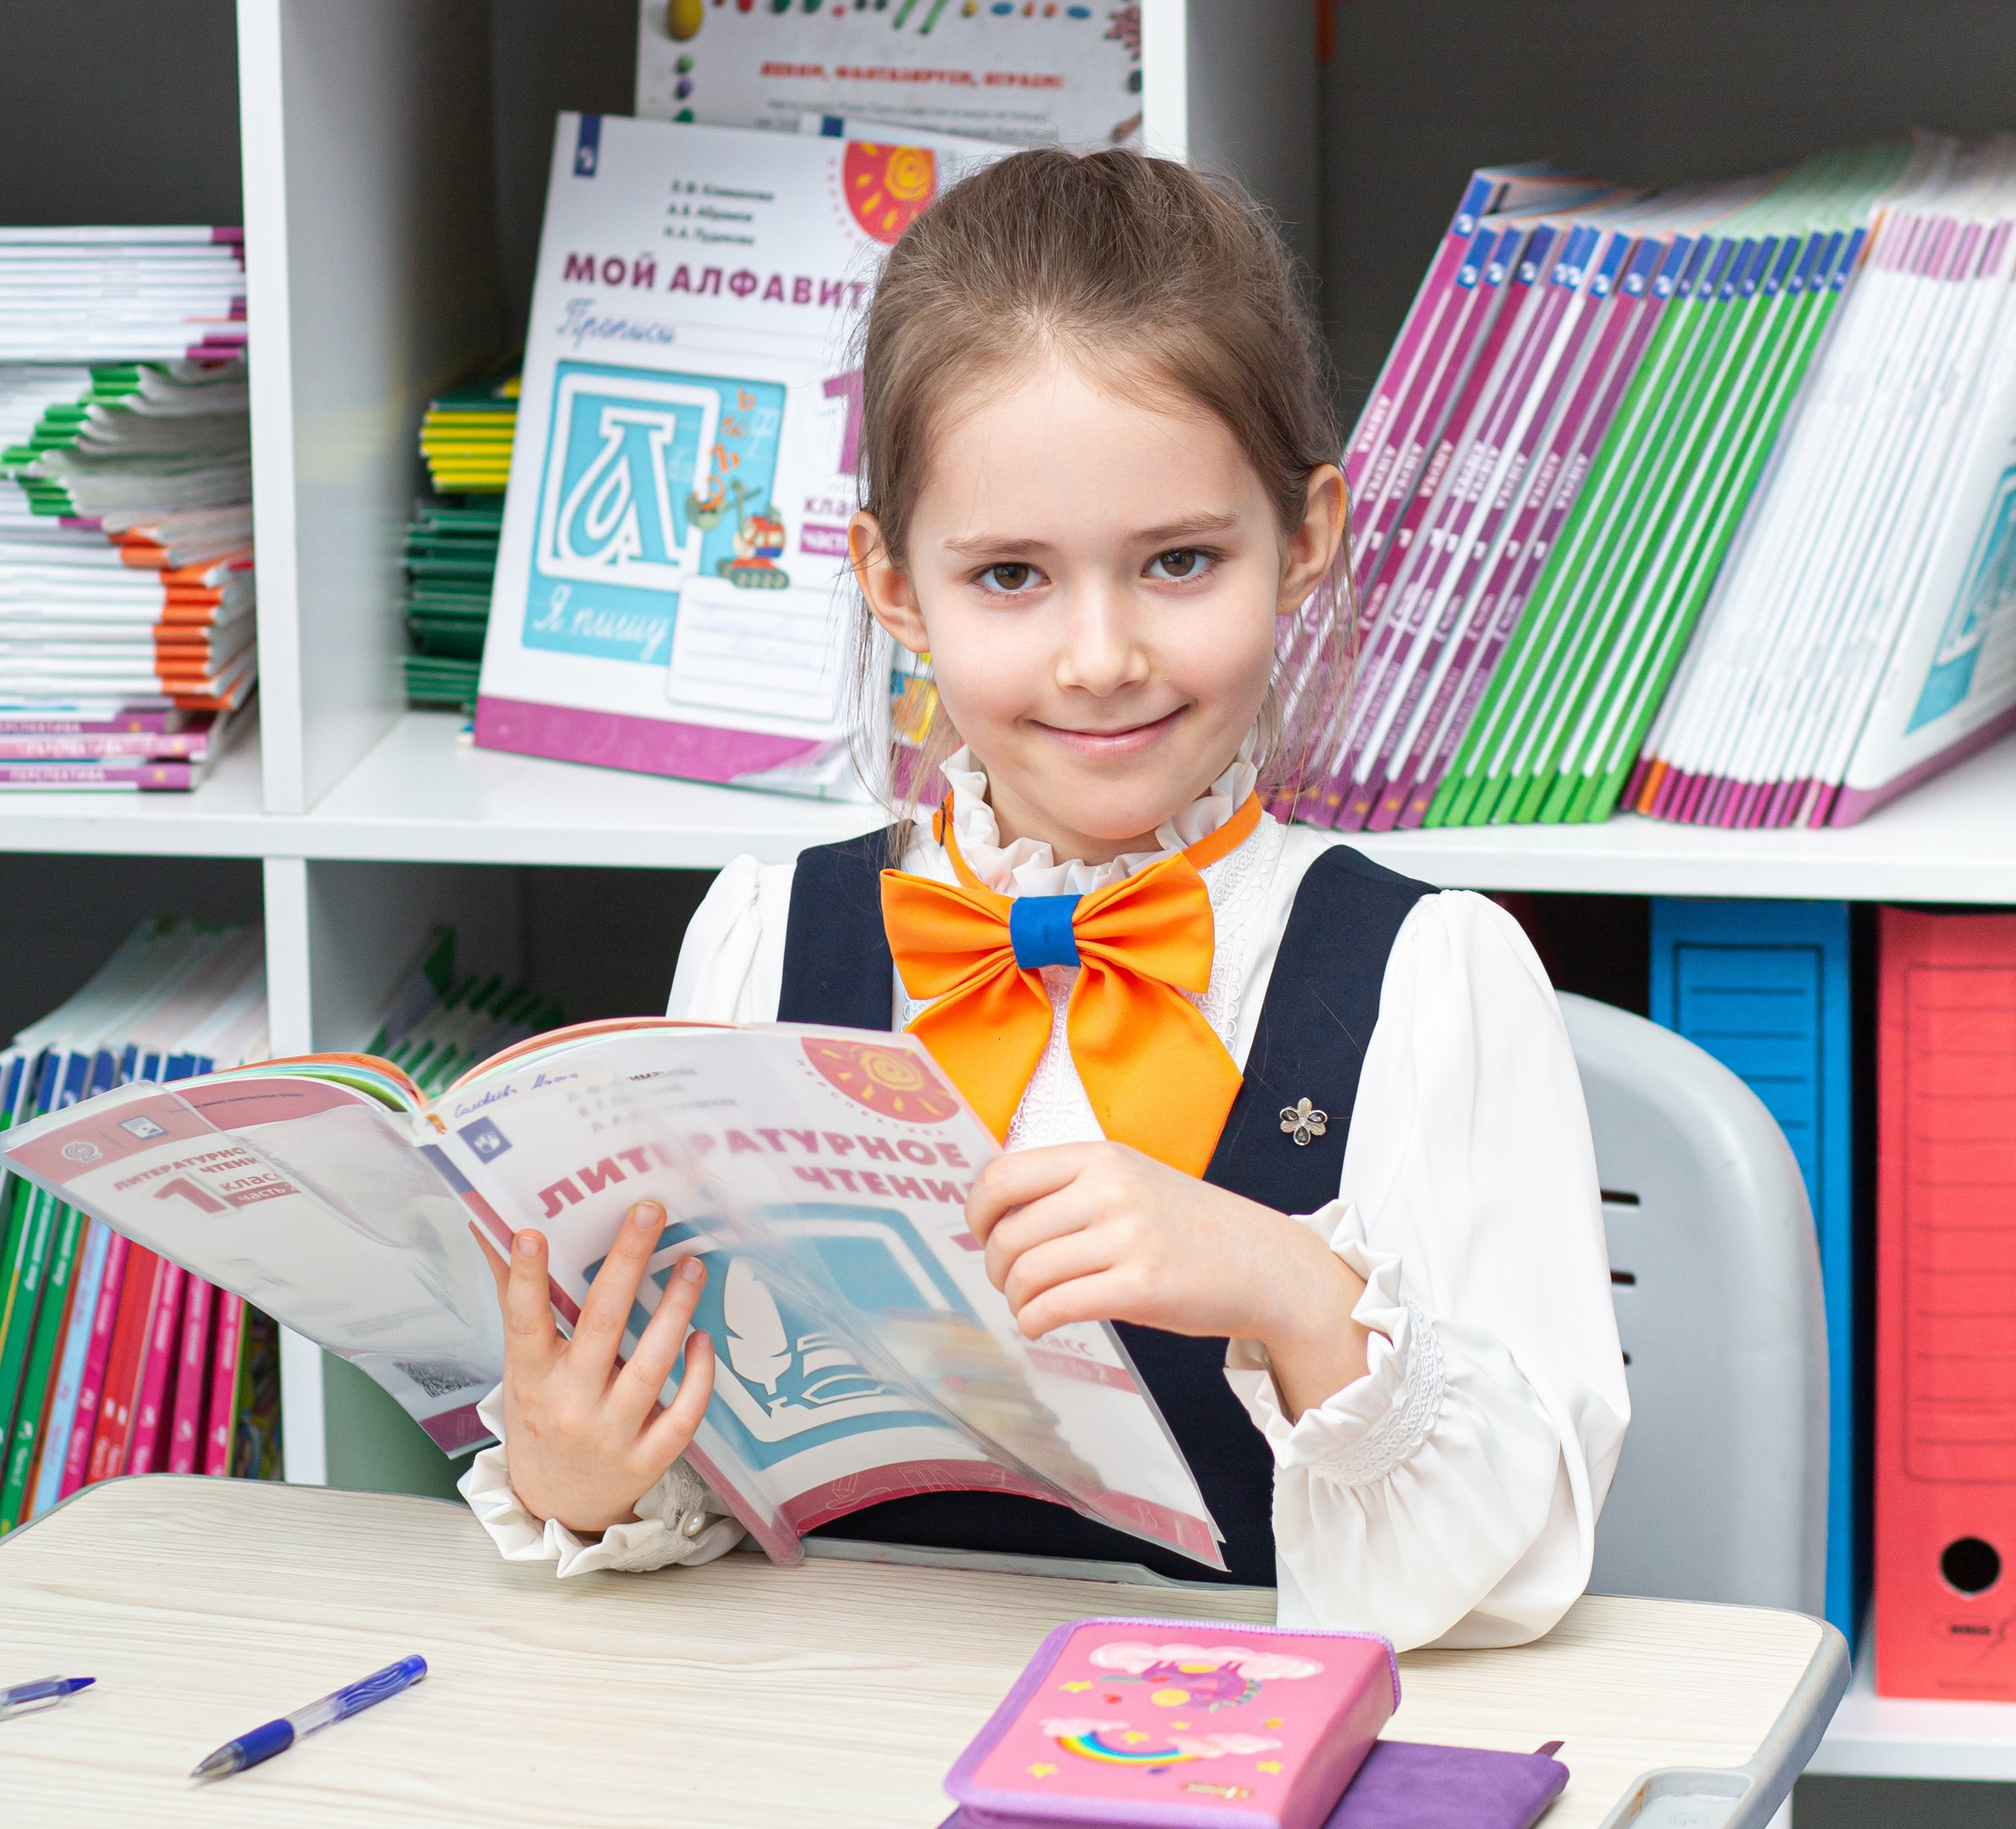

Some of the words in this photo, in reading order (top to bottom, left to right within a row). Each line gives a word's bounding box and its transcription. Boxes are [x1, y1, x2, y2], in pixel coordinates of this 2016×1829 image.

[563, 250, 657, 290] МОЙ
[668, 262, 869, 310] АЛФАВИТ
[113, 1147, 248, 1191] ЛИТЕРАТУРНО
[198, 1156, 262, 1174] ЧТЕНИ
[152, 1176, 230, 1215] 1
[791, 1166, 973, 1206] ЧТЕНИ
